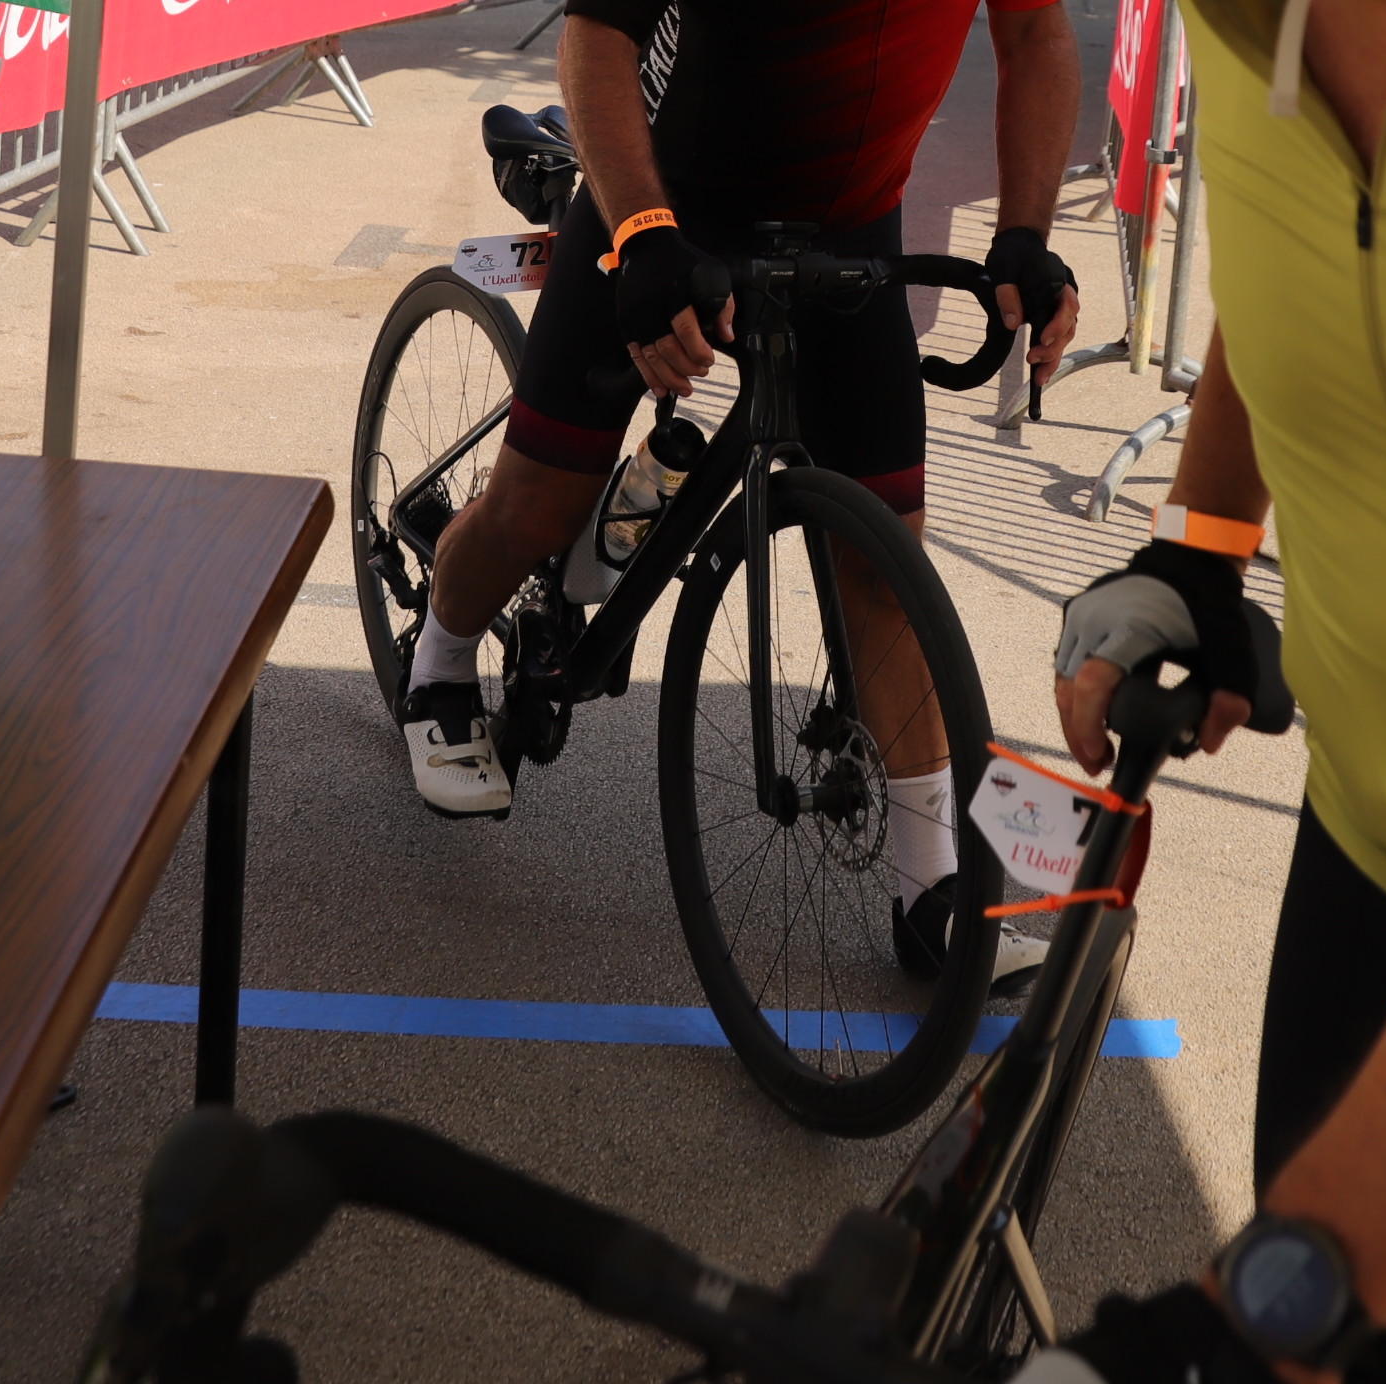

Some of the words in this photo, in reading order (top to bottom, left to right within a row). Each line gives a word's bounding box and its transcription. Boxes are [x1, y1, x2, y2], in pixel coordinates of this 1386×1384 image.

[510, 241, 547, 268] 72
[1073, 795, 1103, 848] 7
[1011, 841, 1081, 876] L'Uxell'
